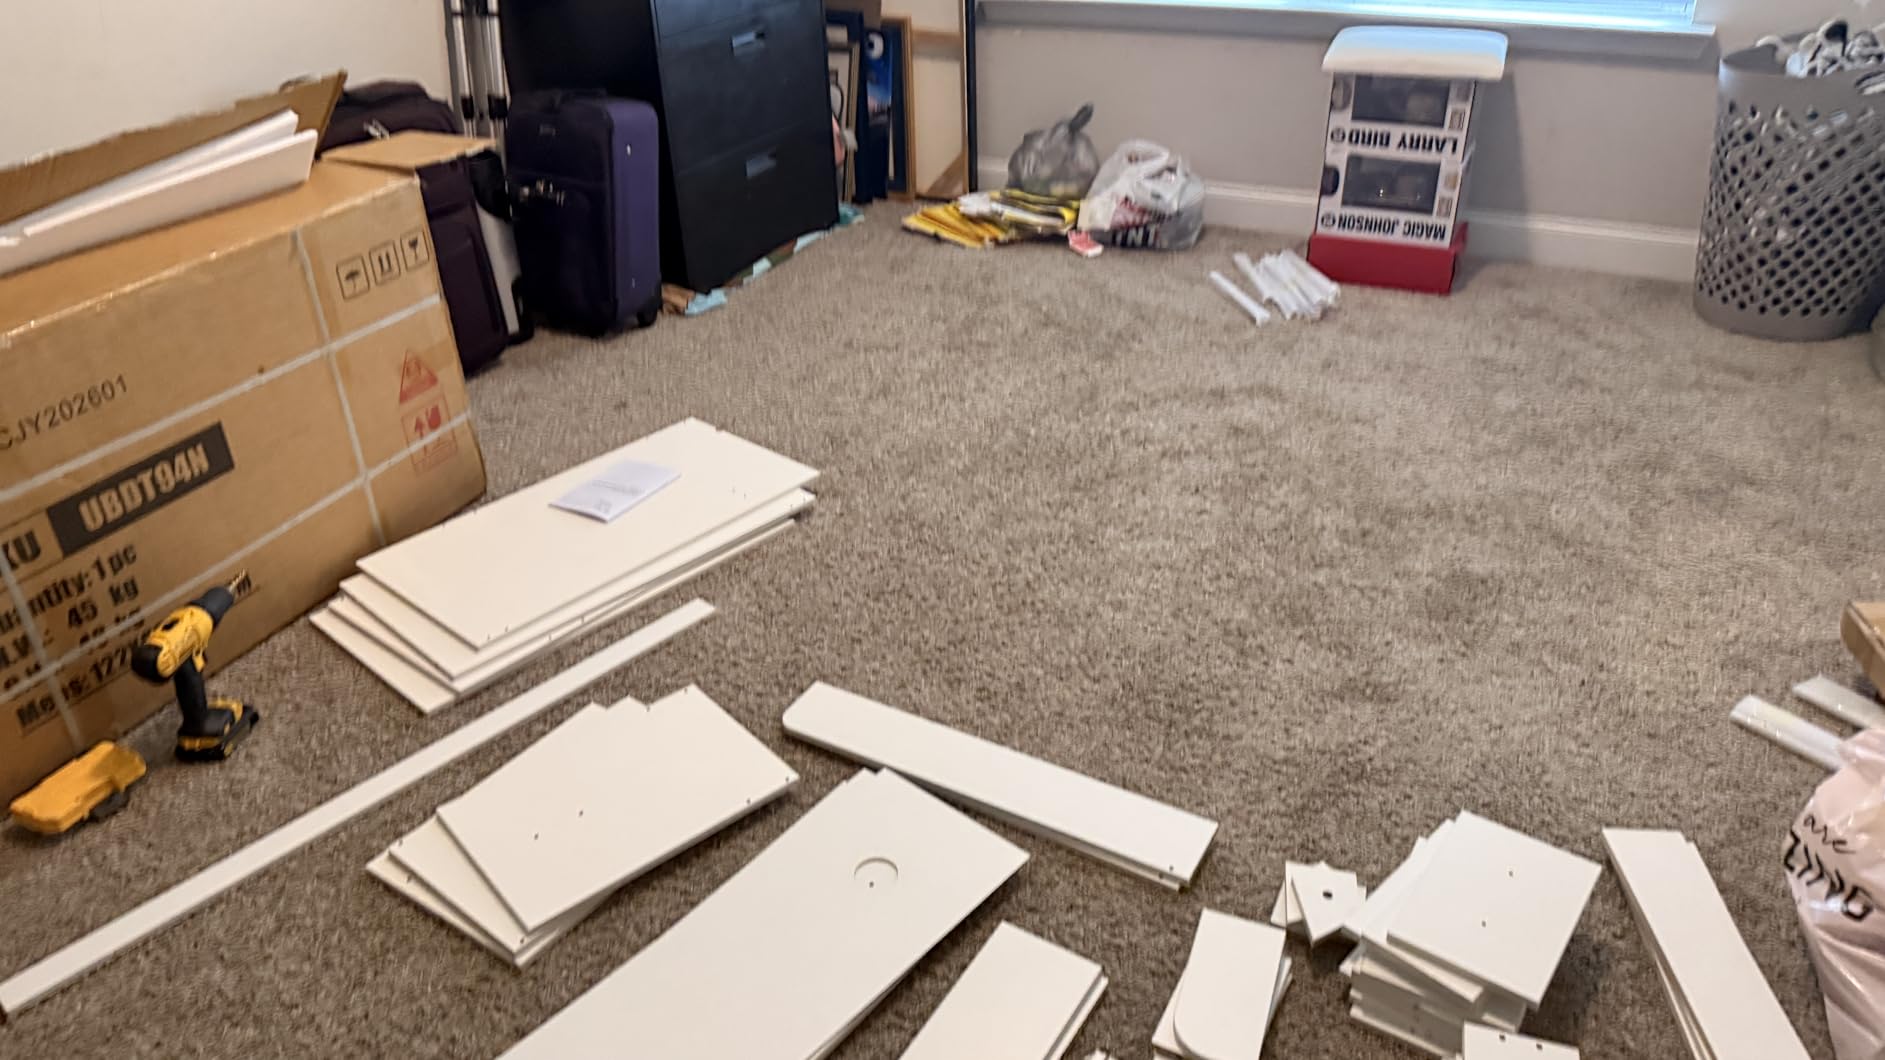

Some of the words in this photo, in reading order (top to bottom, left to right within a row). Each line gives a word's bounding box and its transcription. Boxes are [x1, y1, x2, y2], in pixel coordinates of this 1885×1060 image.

[1348, 127, 1391, 148] BIRD
[1398, 132, 1458, 154] LARRY
[1337, 212, 1399, 235] JOHNSON
[1402, 222, 1446, 241] MAGIC
[108, 575, 139, 607] kg
